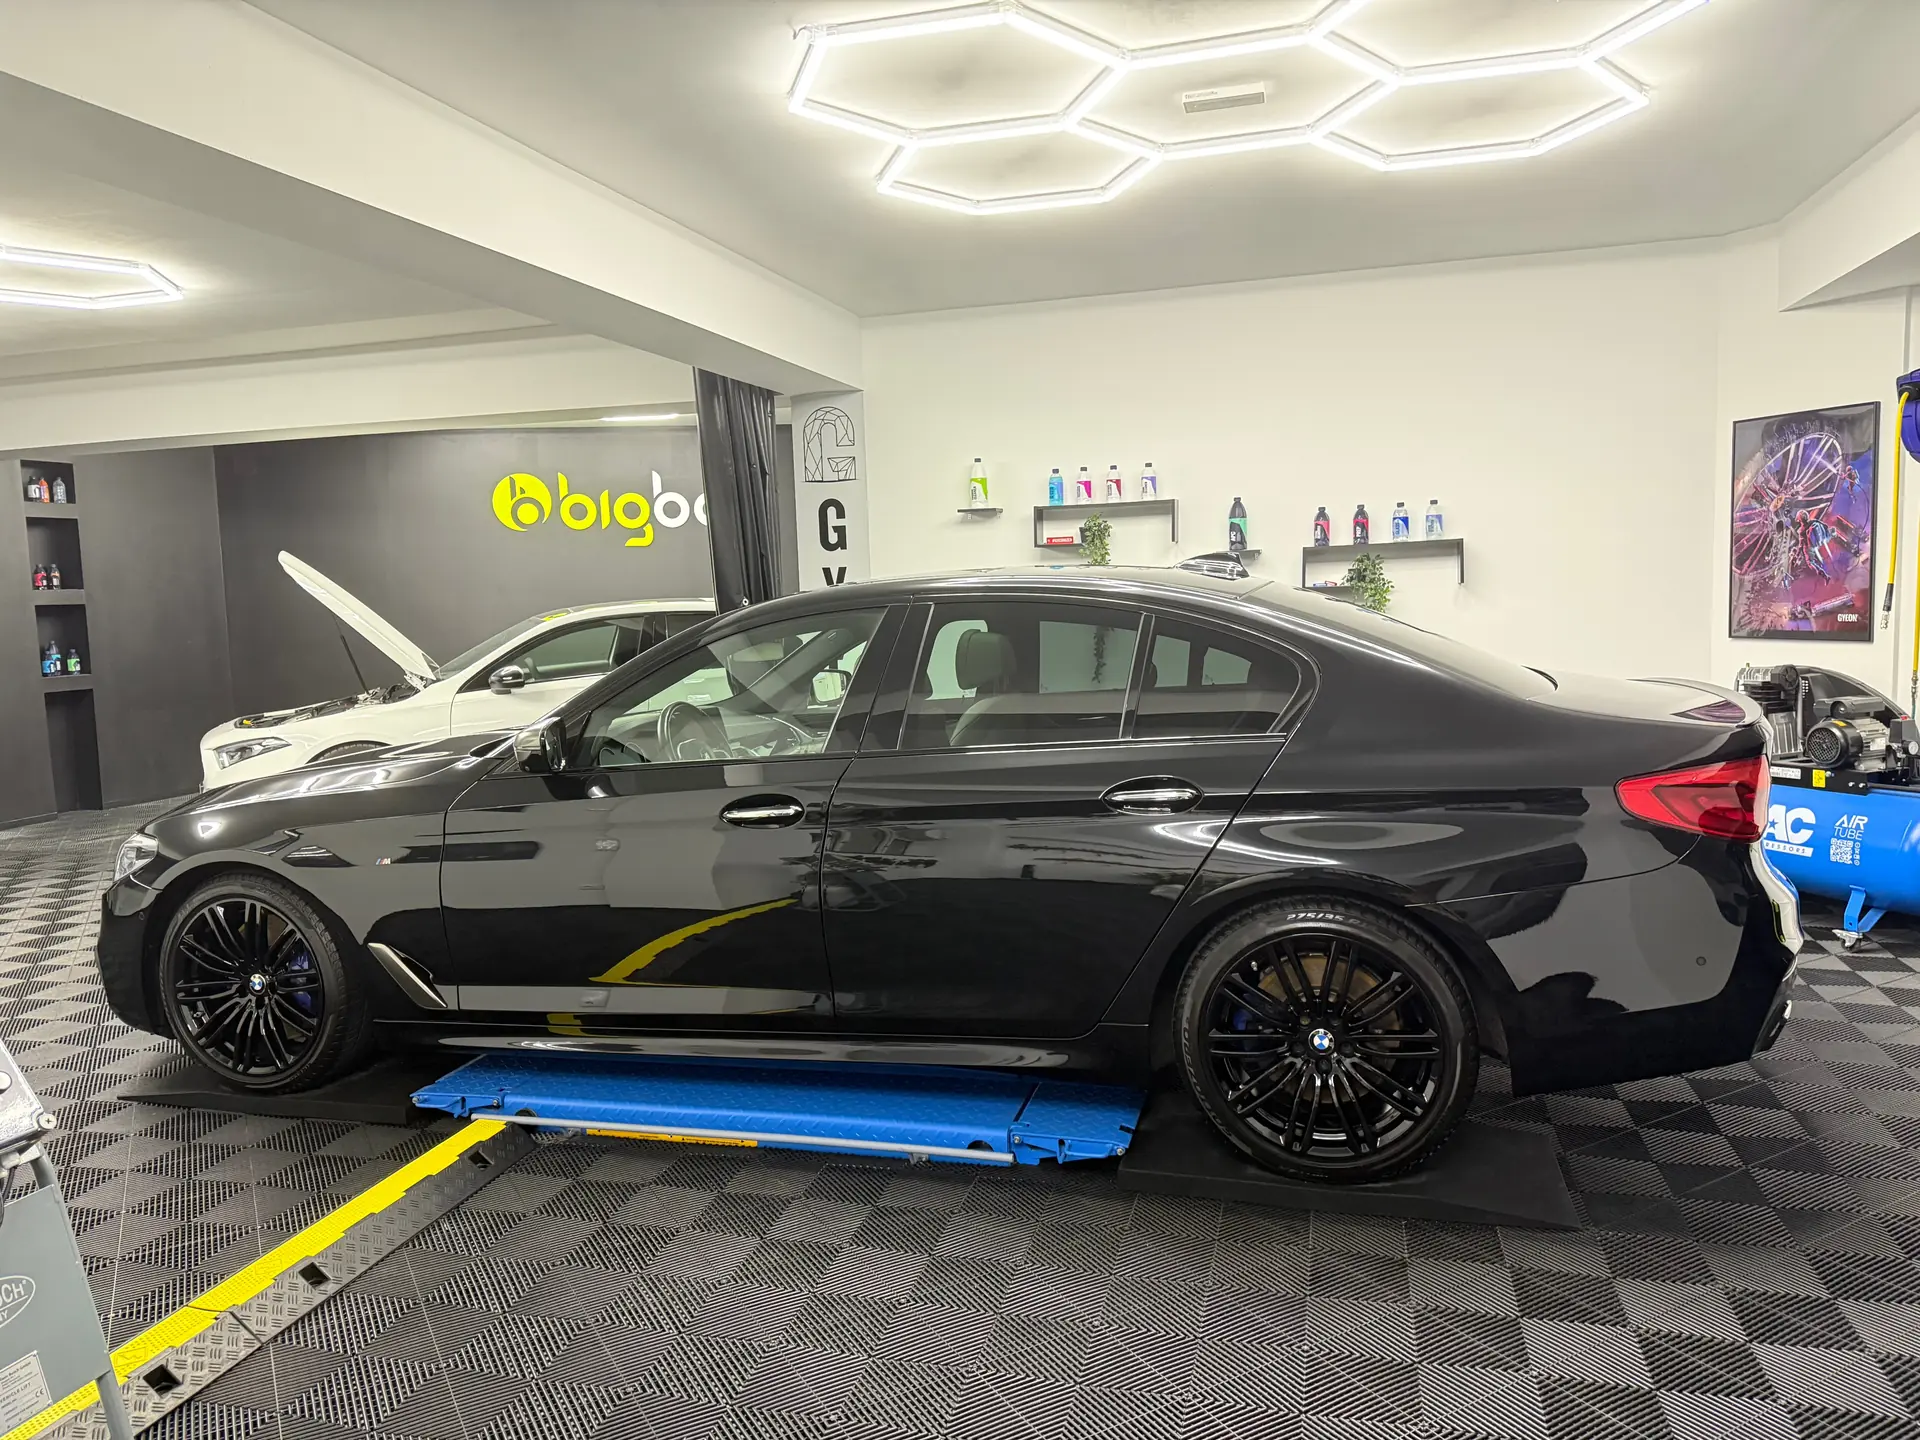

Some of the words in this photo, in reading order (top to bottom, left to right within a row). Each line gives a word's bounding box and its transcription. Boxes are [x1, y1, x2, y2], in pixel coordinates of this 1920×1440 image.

[1837, 613, 1858, 623] GYEON
[1834, 814, 1869, 830] AIR
[1834, 826, 1865, 841] TUBE
